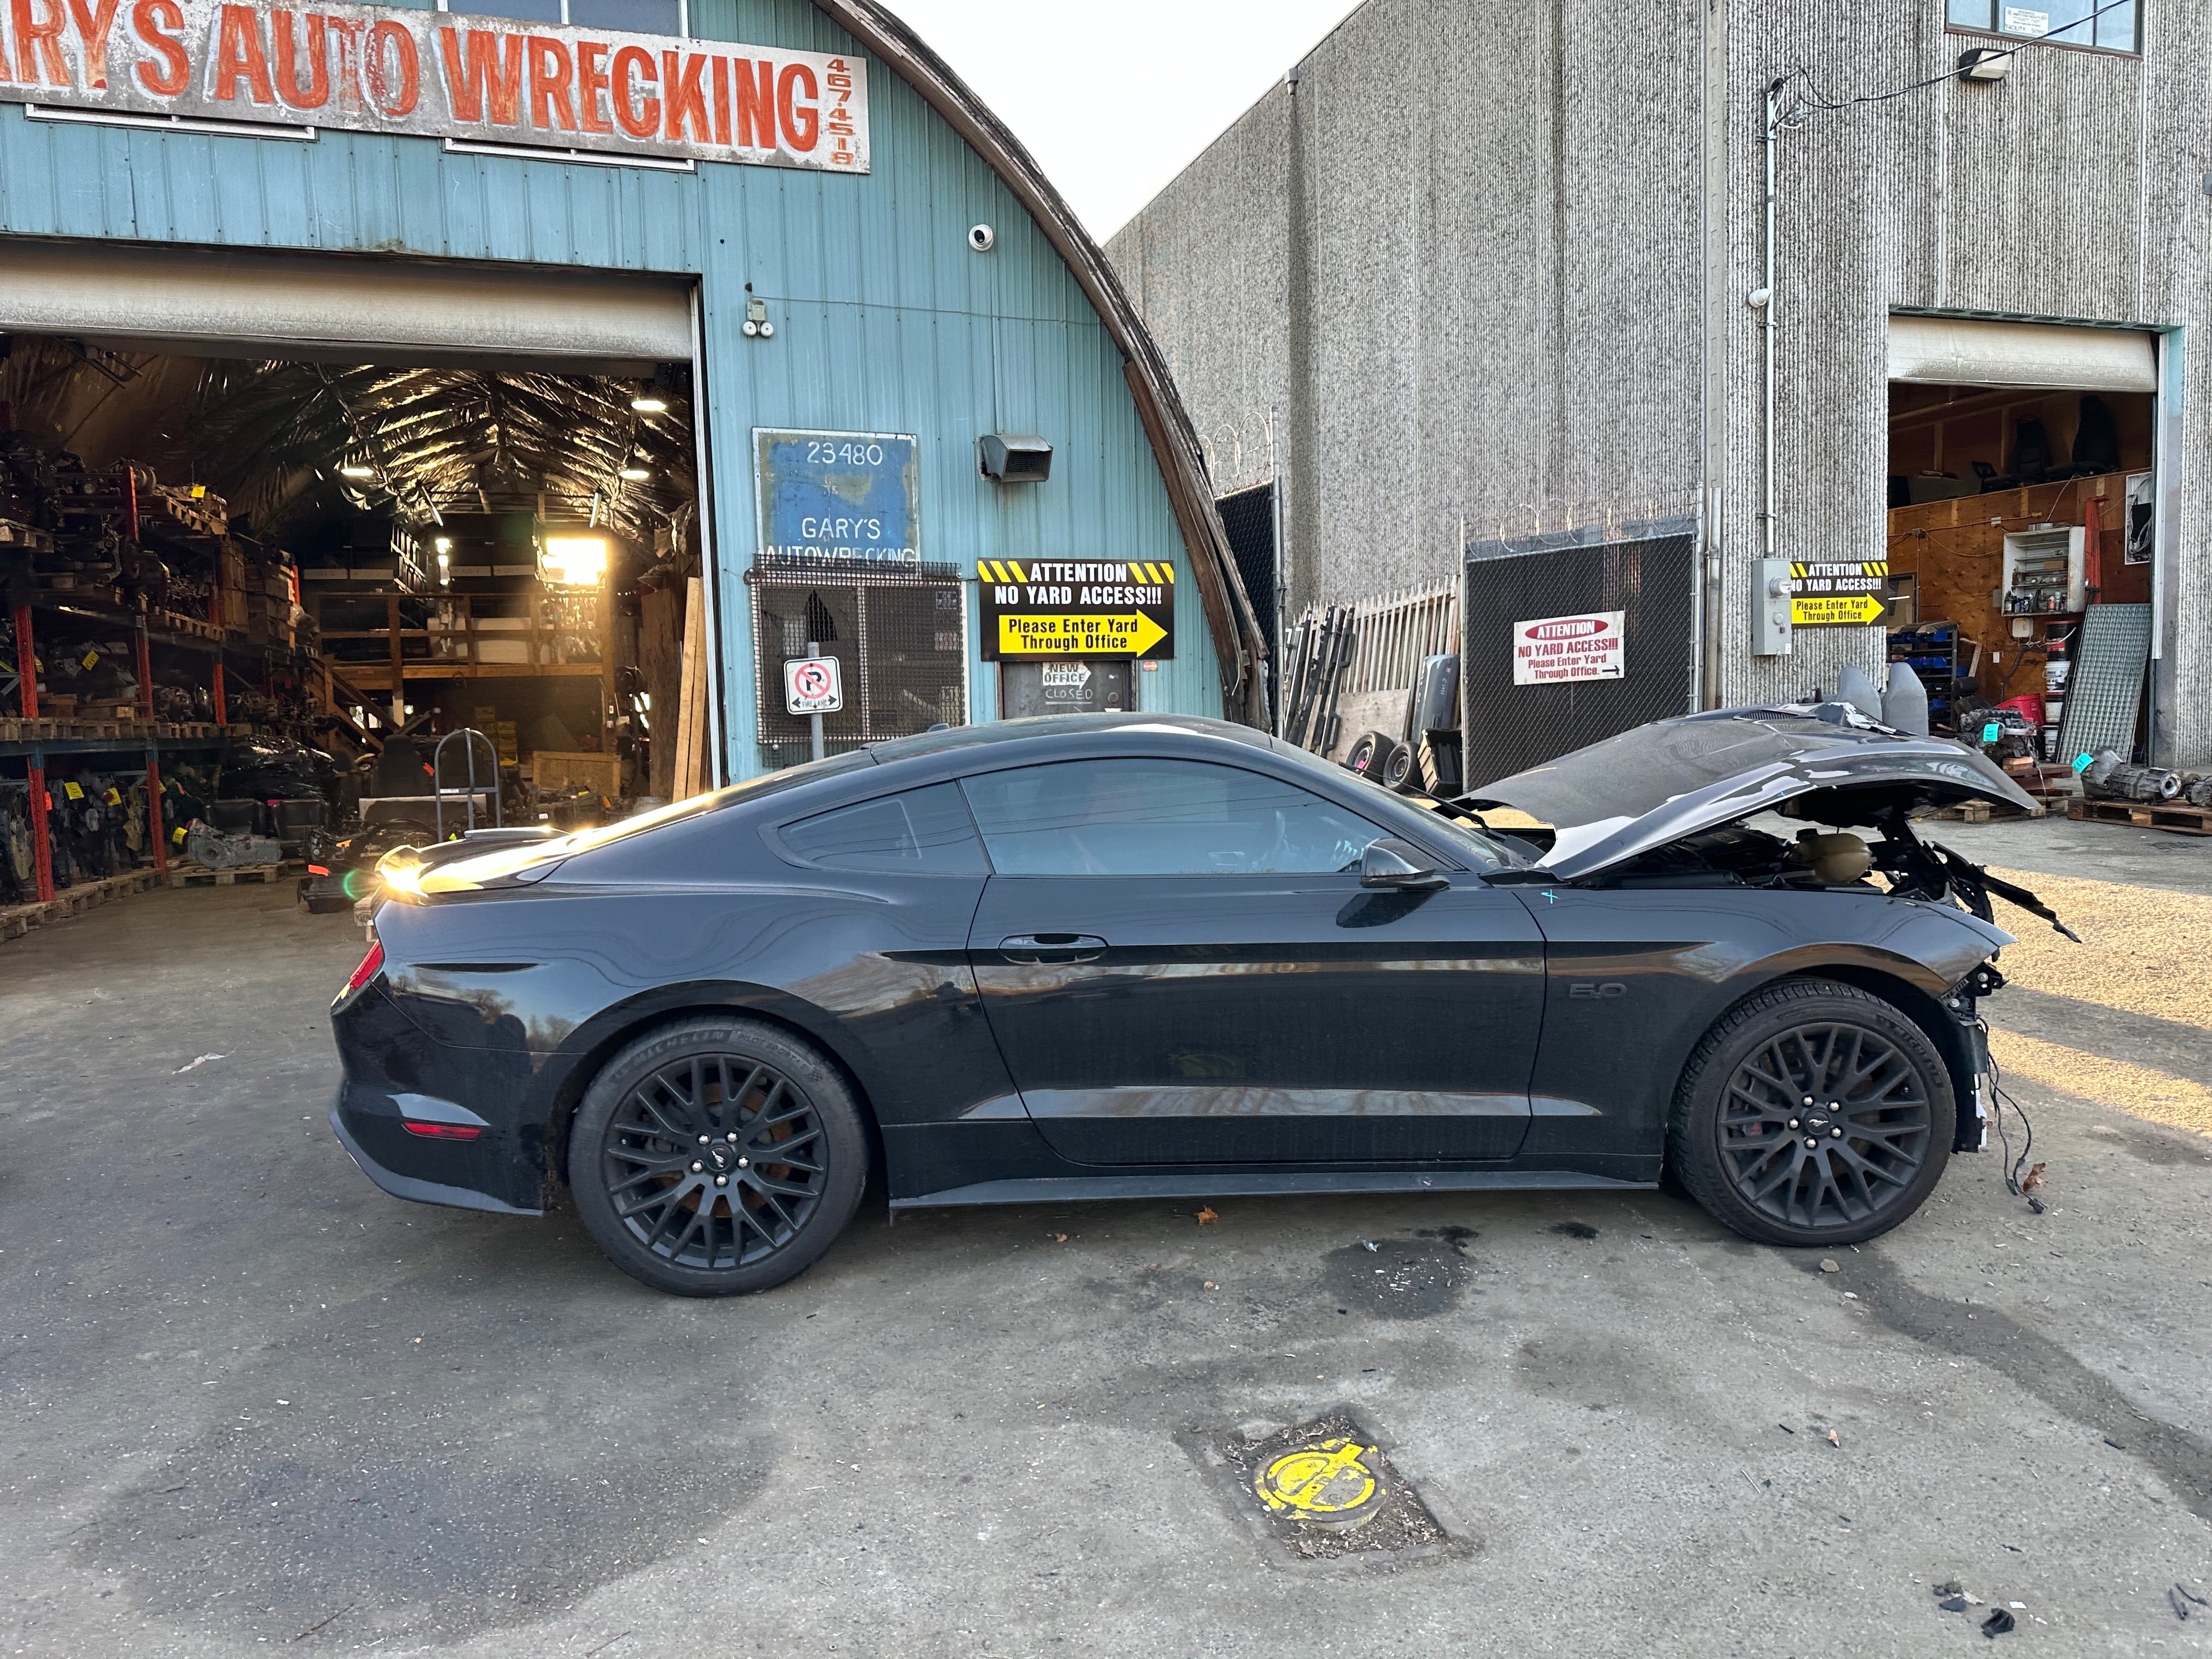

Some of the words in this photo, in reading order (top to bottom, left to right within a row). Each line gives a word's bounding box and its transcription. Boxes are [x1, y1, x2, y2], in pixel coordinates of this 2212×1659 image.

[0, 0, 190, 96] RYS
[214, 4, 419, 116] AUTO
[439, 27, 819, 152] WRECKING
[807, 441, 882, 465] 23480
[802, 518, 880, 539] GARY'S
[1030, 563, 1127, 582] ATTENTION
[1808, 563, 1862, 577] ATTENTION
[1791, 579, 1802, 592] NO
[1806, 578, 1832, 592] YARD
[1835, 578, 1881, 591] ACCESS!!!
[995, 585, 1019, 605] NO
[1027, 586, 1072, 605] YARD
[1080, 586, 1161, 605] ACCESS!!!
[1797, 600, 1823, 611] Please
[1826, 600, 1847, 609] Enter
[1851, 599, 1868, 609] Yard
[1803, 611, 1835, 622] Through
[1838, 611, 1862, 620] Office
[1009, 618, 1056, 633] Please
[1063, 619, 1101, 633] Enter
[1108, 619, 1138, 632] Yard
[1537, 620, 1595, 638] ATTENTION
[1021, 635, 1078, 652] Through
[1085, 634, 1127, 648] Office
[1518, 645, 1532, 658] NO
[1535, 643, 1563, 656] YARD
[1566, 638, 1619, 654] ACCESS!!!
[1050, 664, 1078, 672] NEW
[1528, 659, 1555, 669] Please
[1557, 657, 1581, 666] Enter
[1584, 653, 1607, 664] Yard
[1044, 672, 1085, 683] OFFICE
[1535, 668, 1568, 679] Through
[1046, 688, 1093, 699] CLOSED
[1569, 983, 1627, 999] 5.0
[634, 1031, 724, 1066] MICHELIN
[737, 1033, 766, 1046] PILOT
[766, 1043, 796, 1060] SPORT
